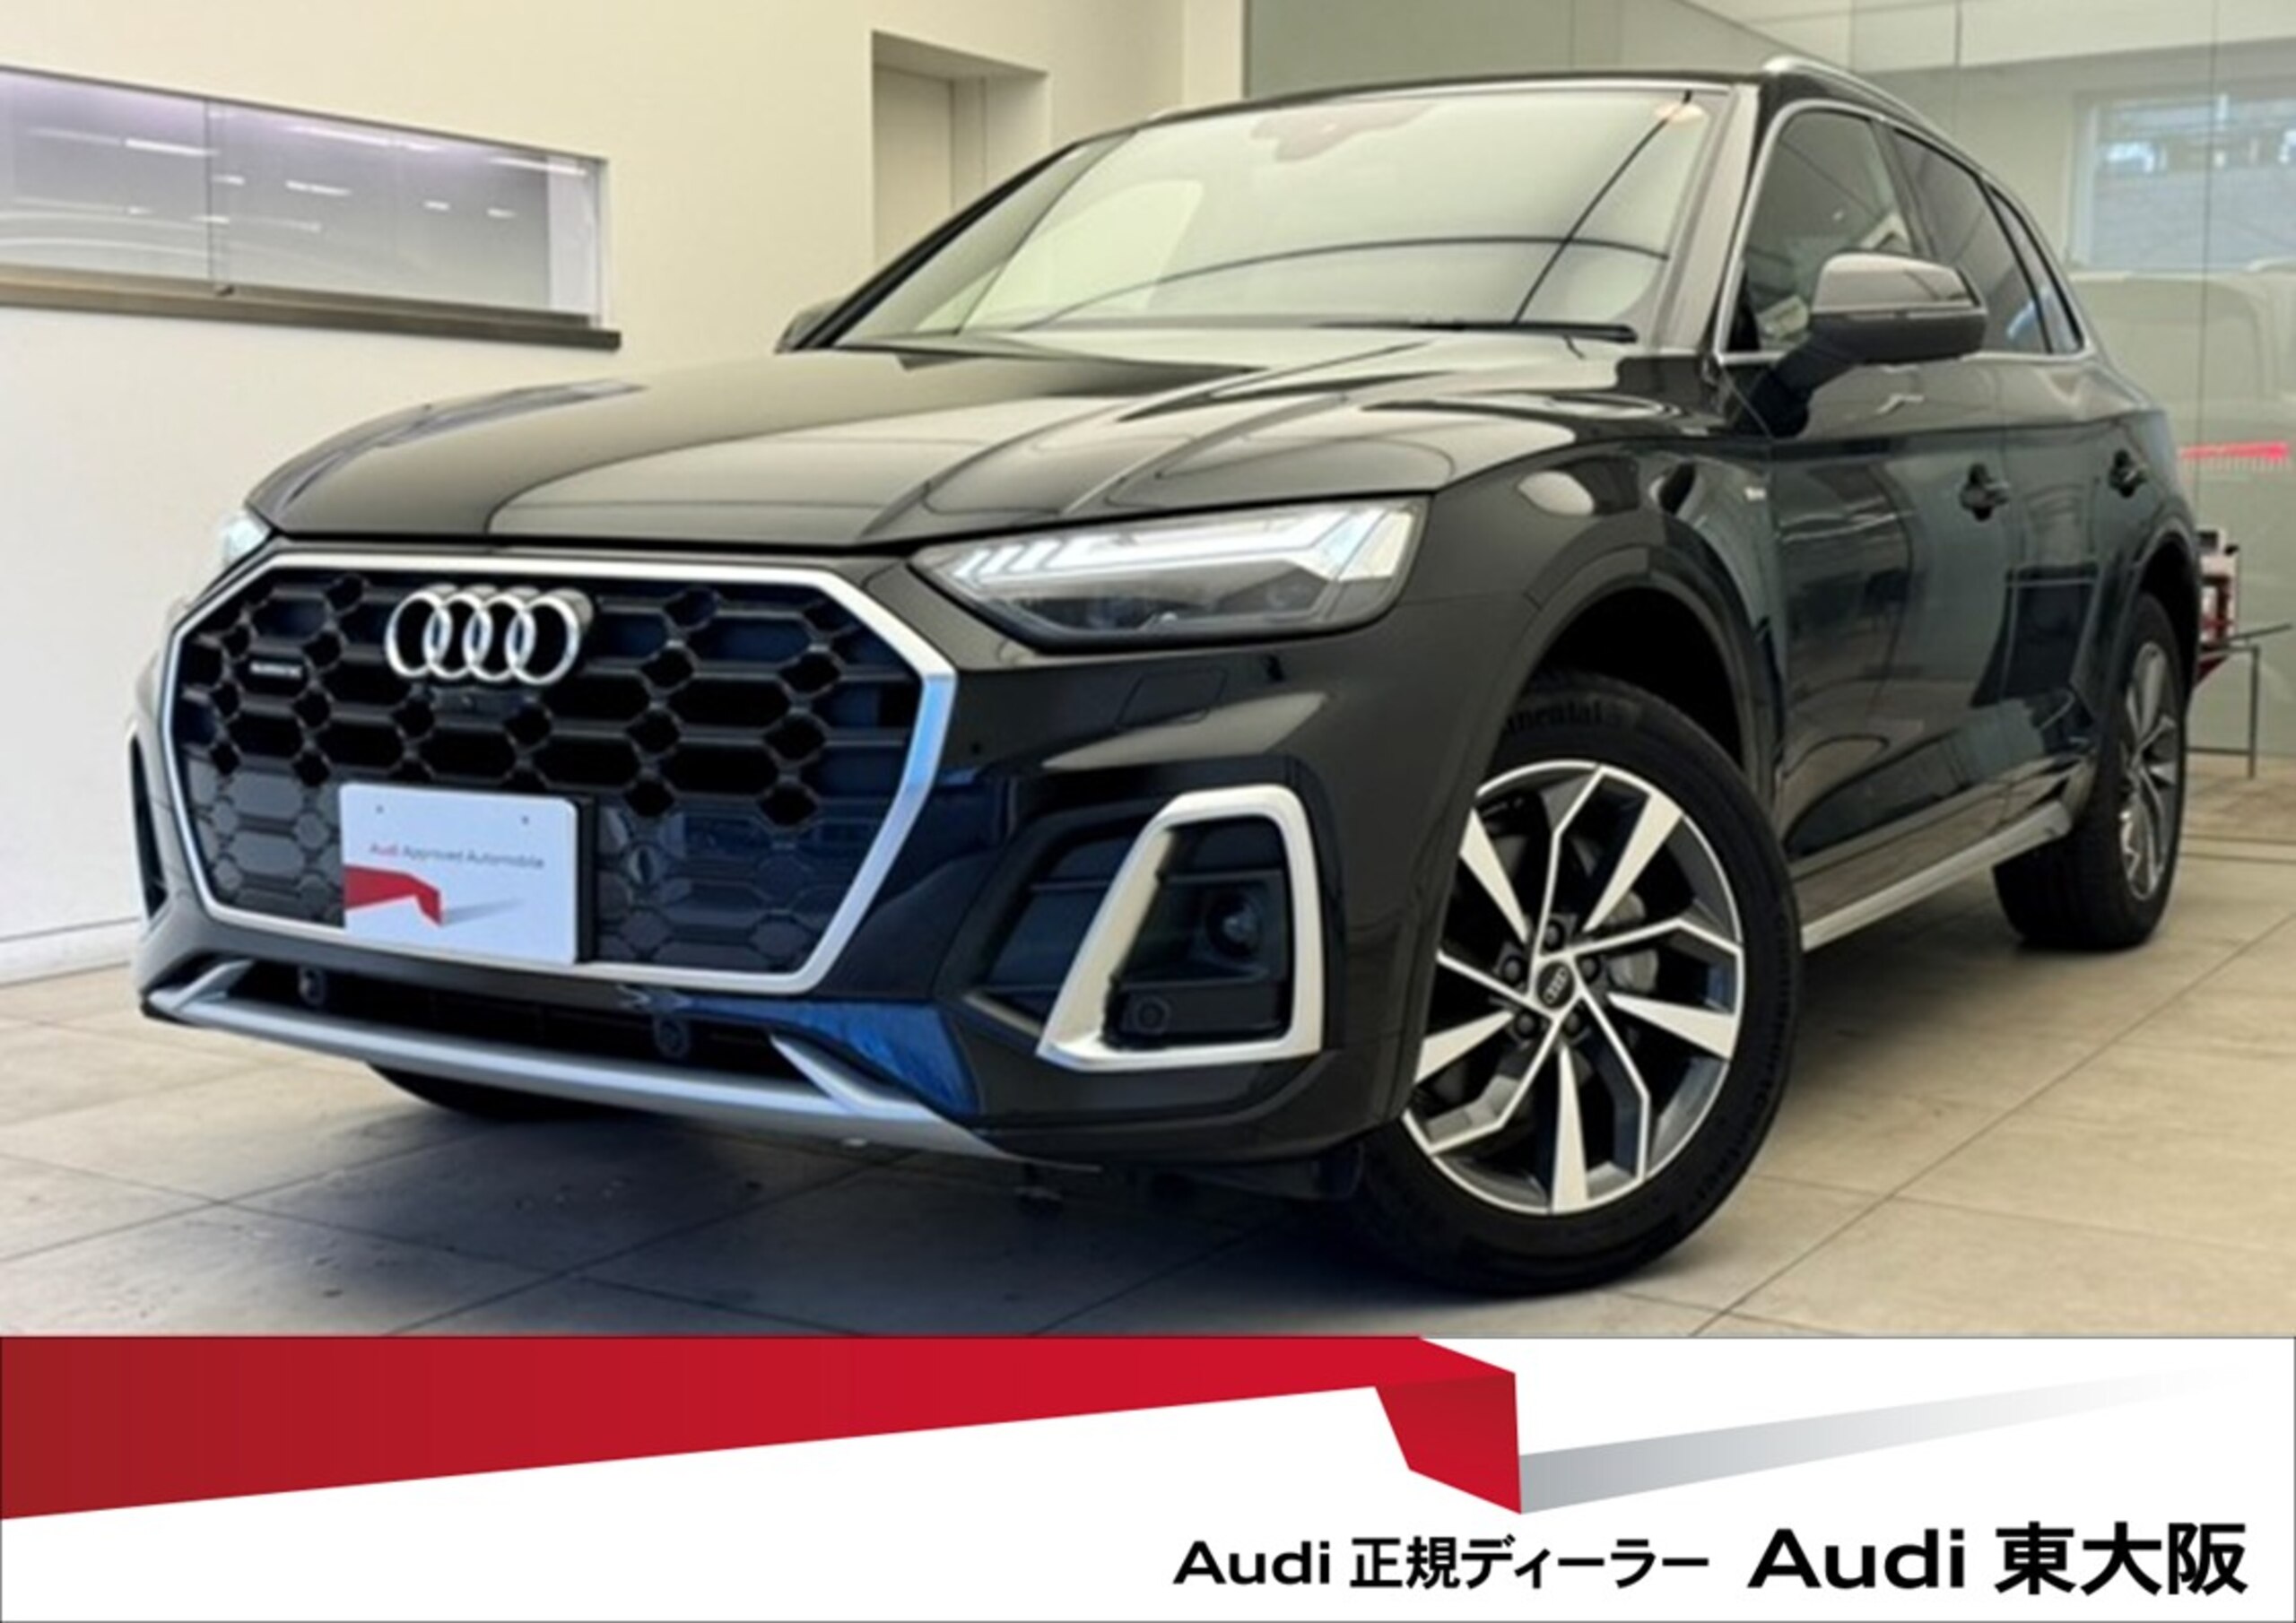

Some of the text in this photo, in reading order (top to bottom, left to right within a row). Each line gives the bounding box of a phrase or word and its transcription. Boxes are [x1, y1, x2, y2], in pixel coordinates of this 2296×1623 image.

[370, 842, 544, 869] Audi Approved Automobile
